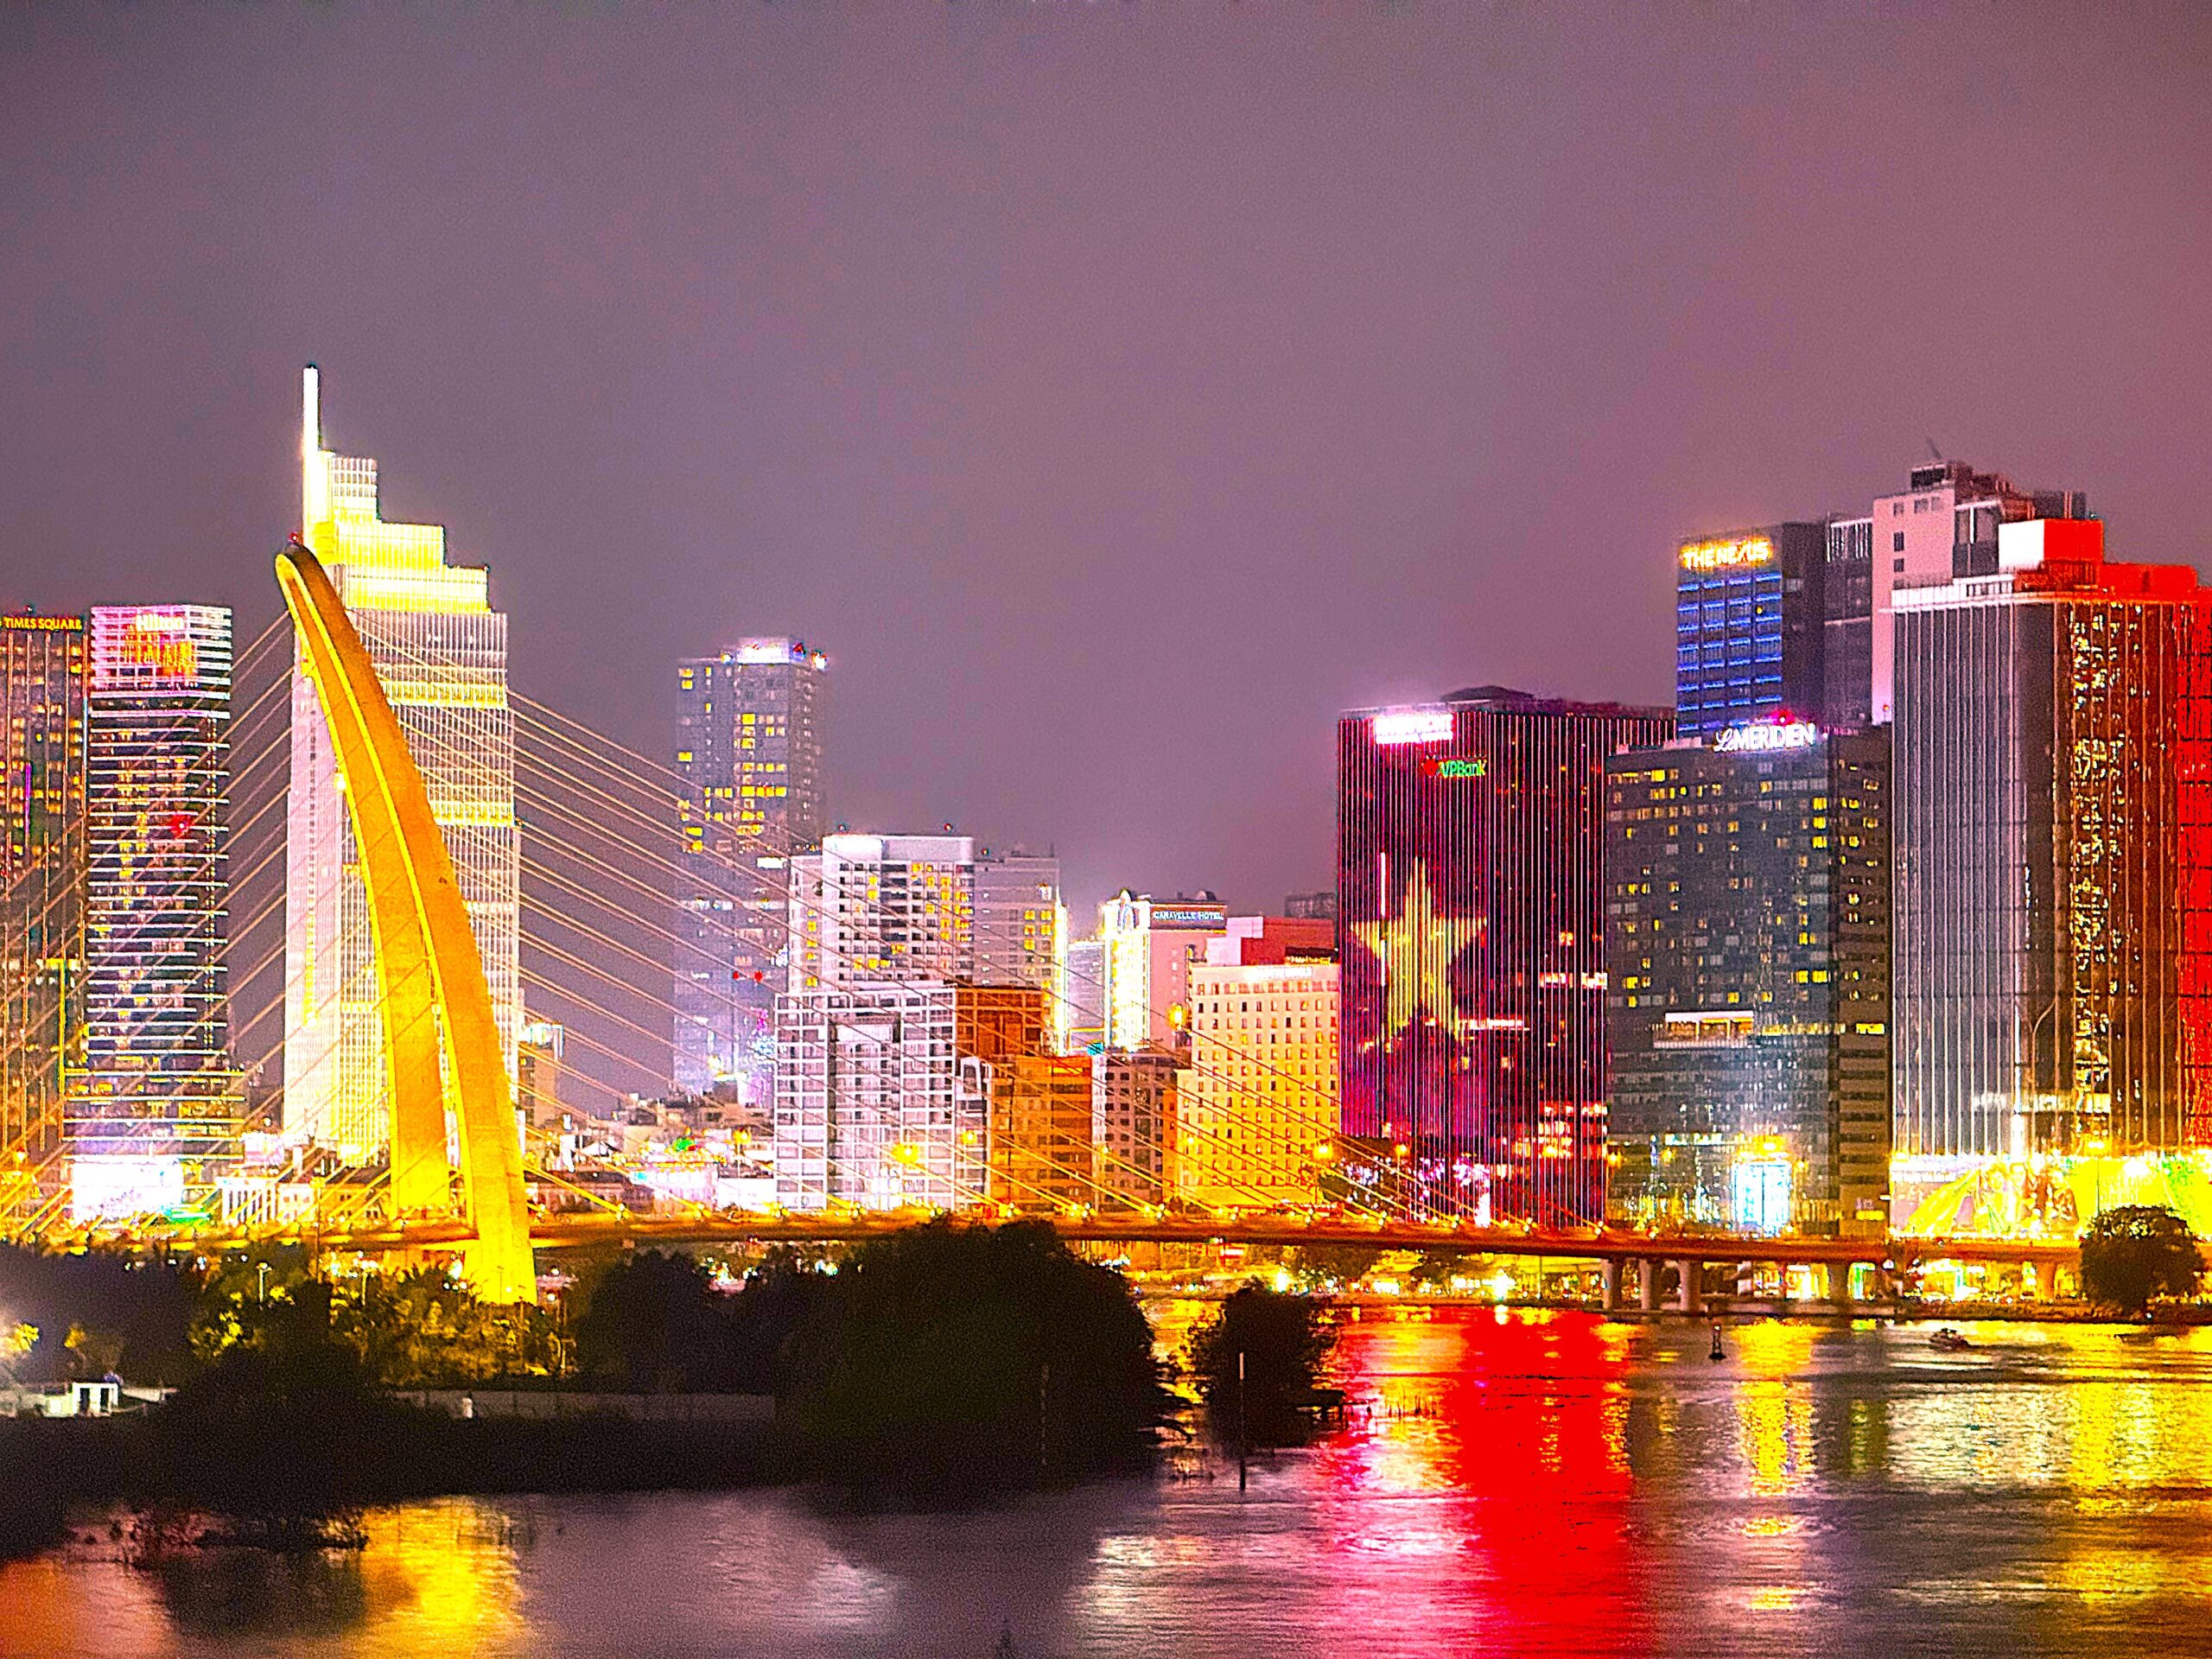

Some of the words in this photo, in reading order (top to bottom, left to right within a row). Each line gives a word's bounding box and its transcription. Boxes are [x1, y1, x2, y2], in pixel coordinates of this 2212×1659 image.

[1682, 548, 1715, 570] THE
[1715, 540, 1770, 565] NEXUS
[3, 616, 37, 629] TIMES
[37, 617, 83, 631] SQUARE
[136, 613, 184, 632] Hilton
[1439, 759, 1487, 779] VPBank
[1153, 911, 1197, 921] CARAVELLE
[1198, 911, 1224, 921] HOTEL
